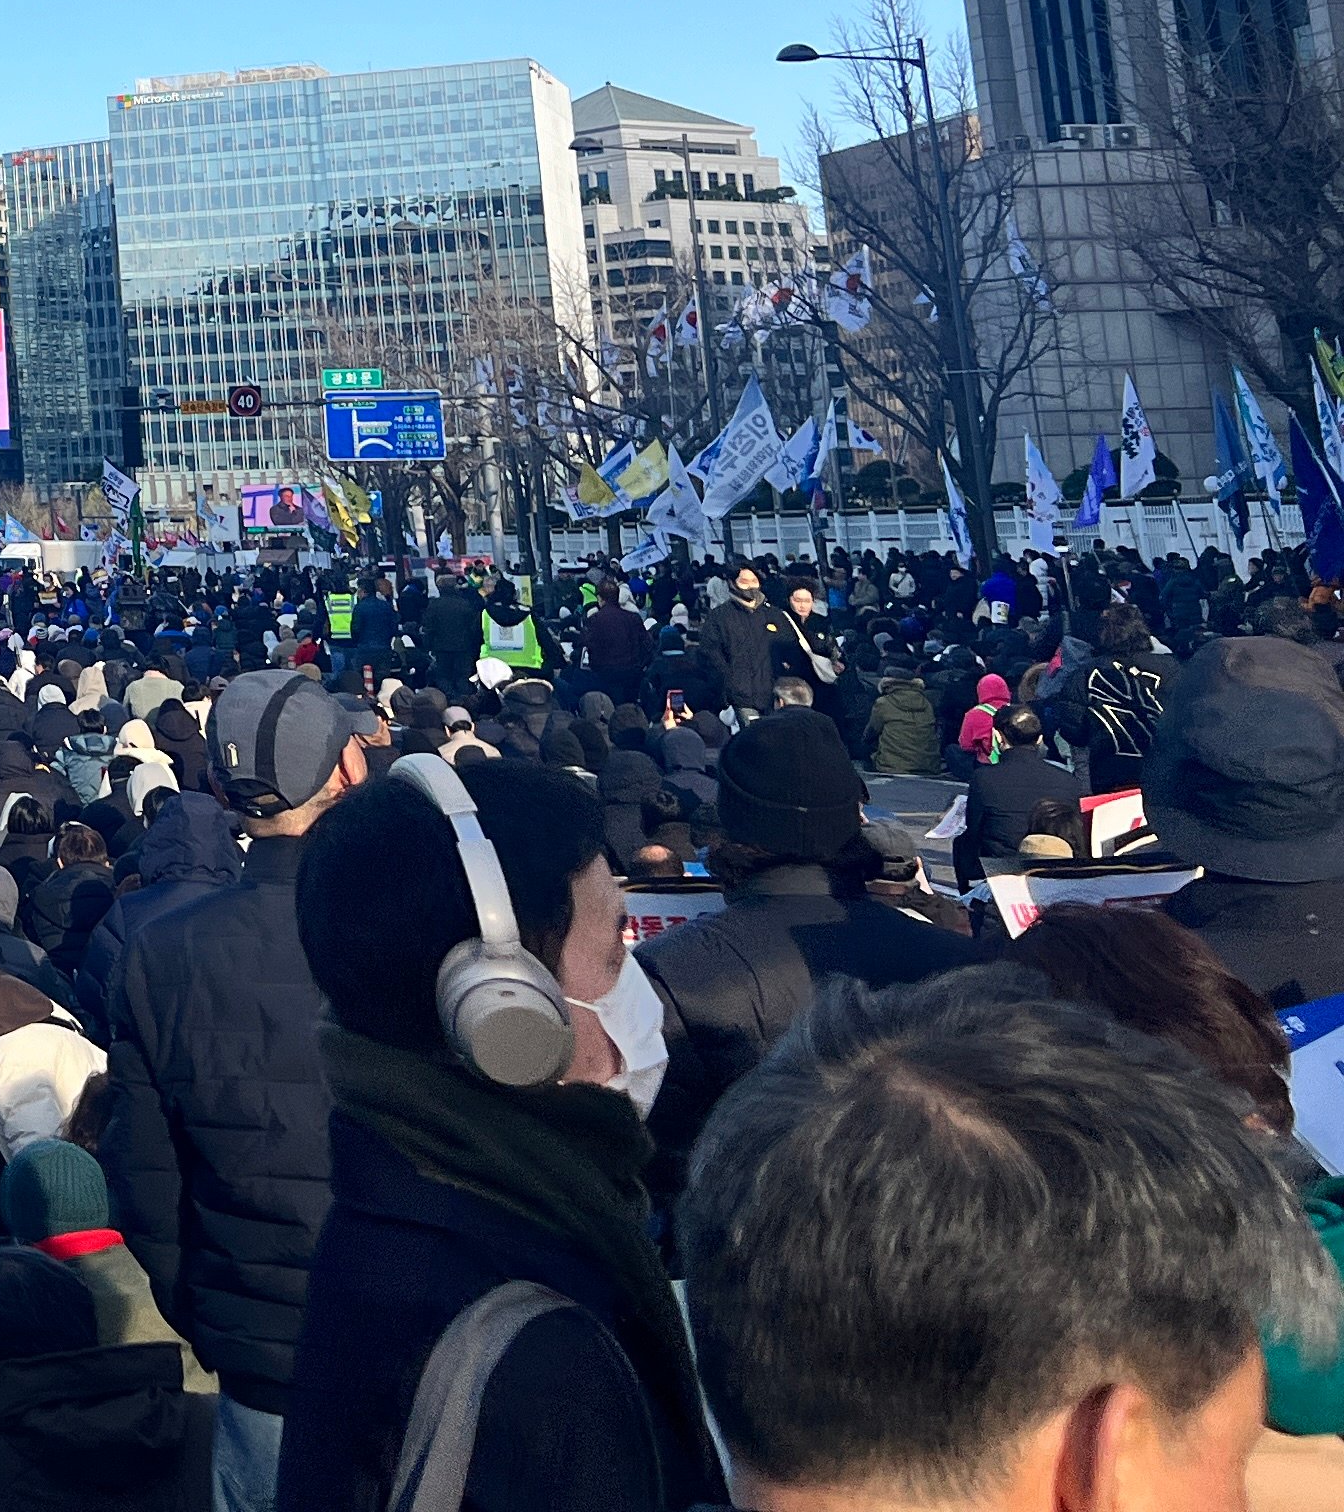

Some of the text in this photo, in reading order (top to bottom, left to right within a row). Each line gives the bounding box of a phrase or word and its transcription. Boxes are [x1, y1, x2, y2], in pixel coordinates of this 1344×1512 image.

[133, 92, 180, 105] Microsoft
[331, 371, 372, 385] 광화문
[238, 395, 254, 408] 40
